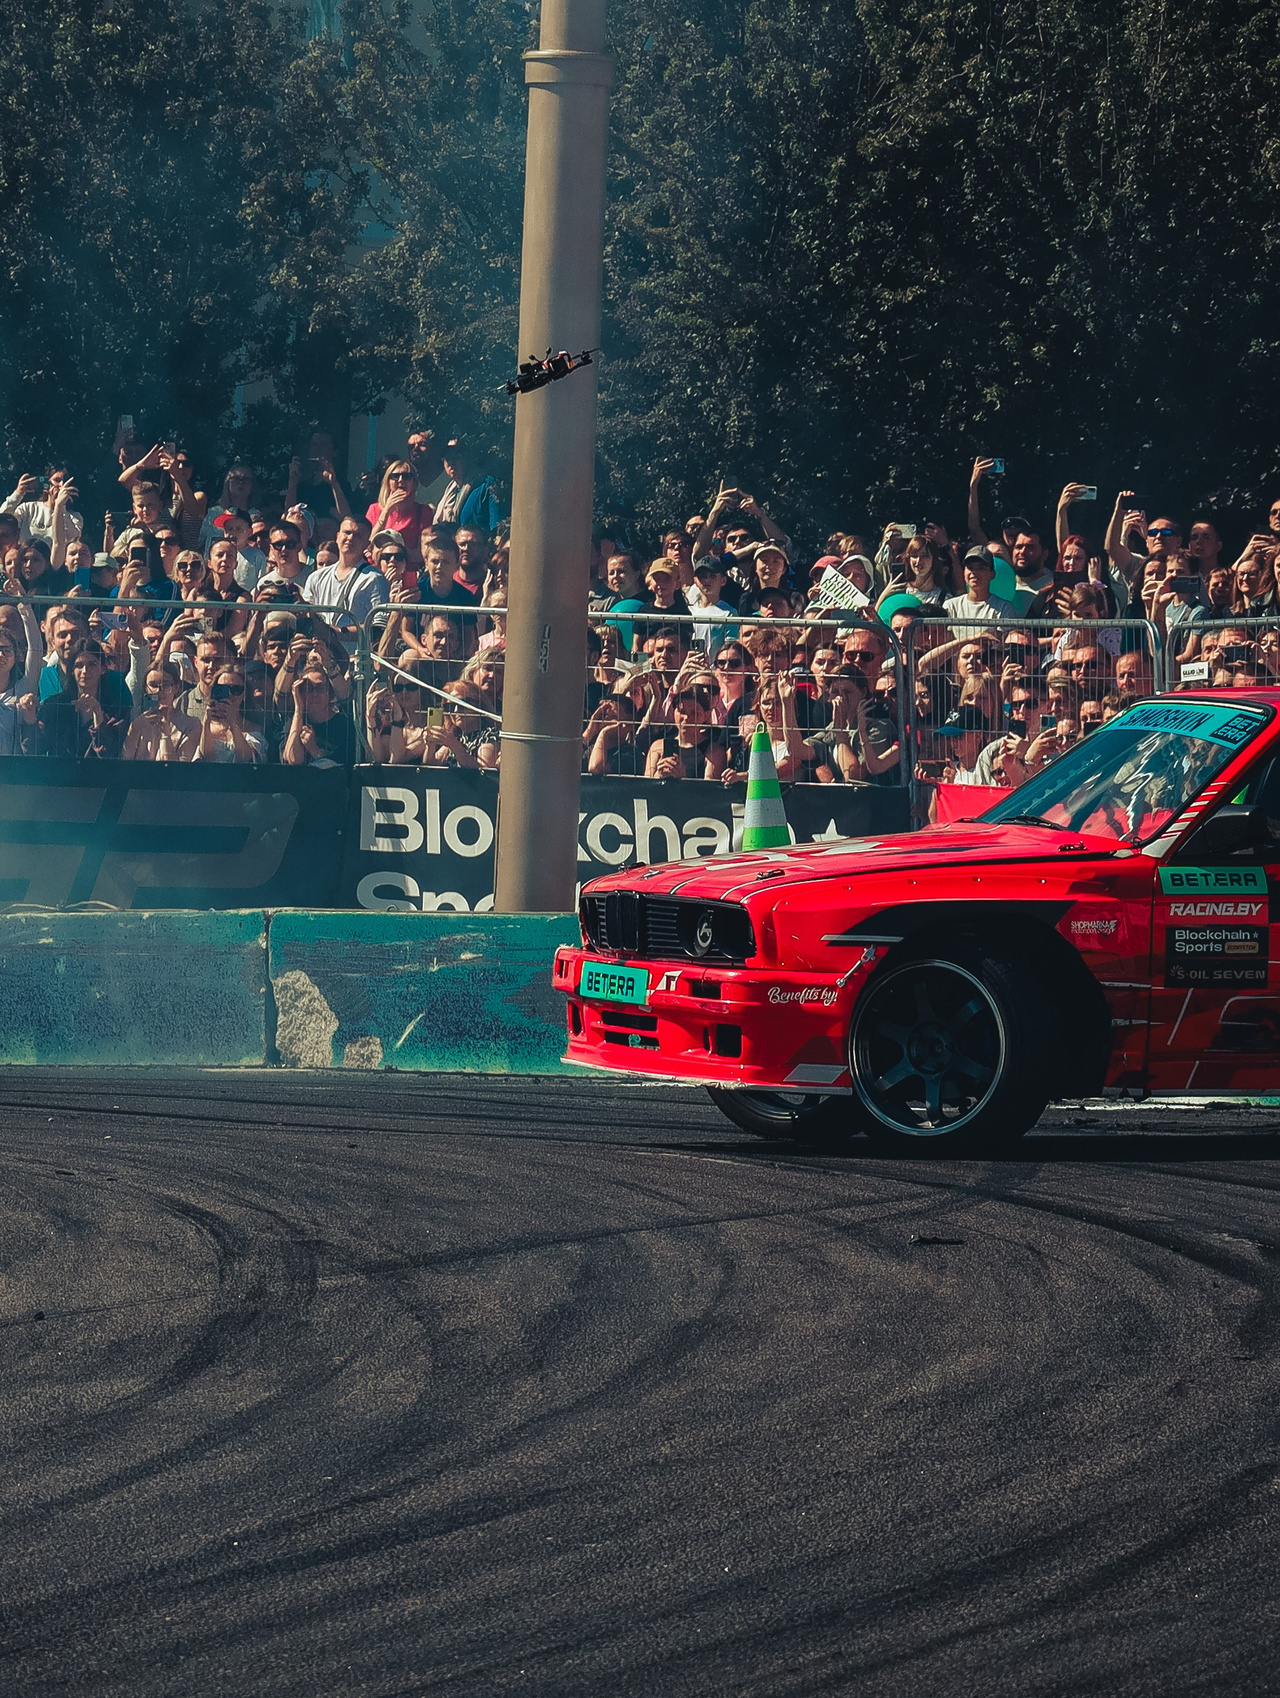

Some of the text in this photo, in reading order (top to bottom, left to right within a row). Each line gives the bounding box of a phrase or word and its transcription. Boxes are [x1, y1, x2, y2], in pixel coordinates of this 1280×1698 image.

[1118, 708, 1216, 733] SAMOSHKIN
[1228, 717, 1261, 732] BET
[1169, 902, 1263, 916] RACING.BY
[1175, 929, 1251, 940] Blockchain
[1175, 941, 1223, 954] Sports
[1213, 970, 1266, 980] SEVEN
[767, 986, 821, 1005] Benefits
